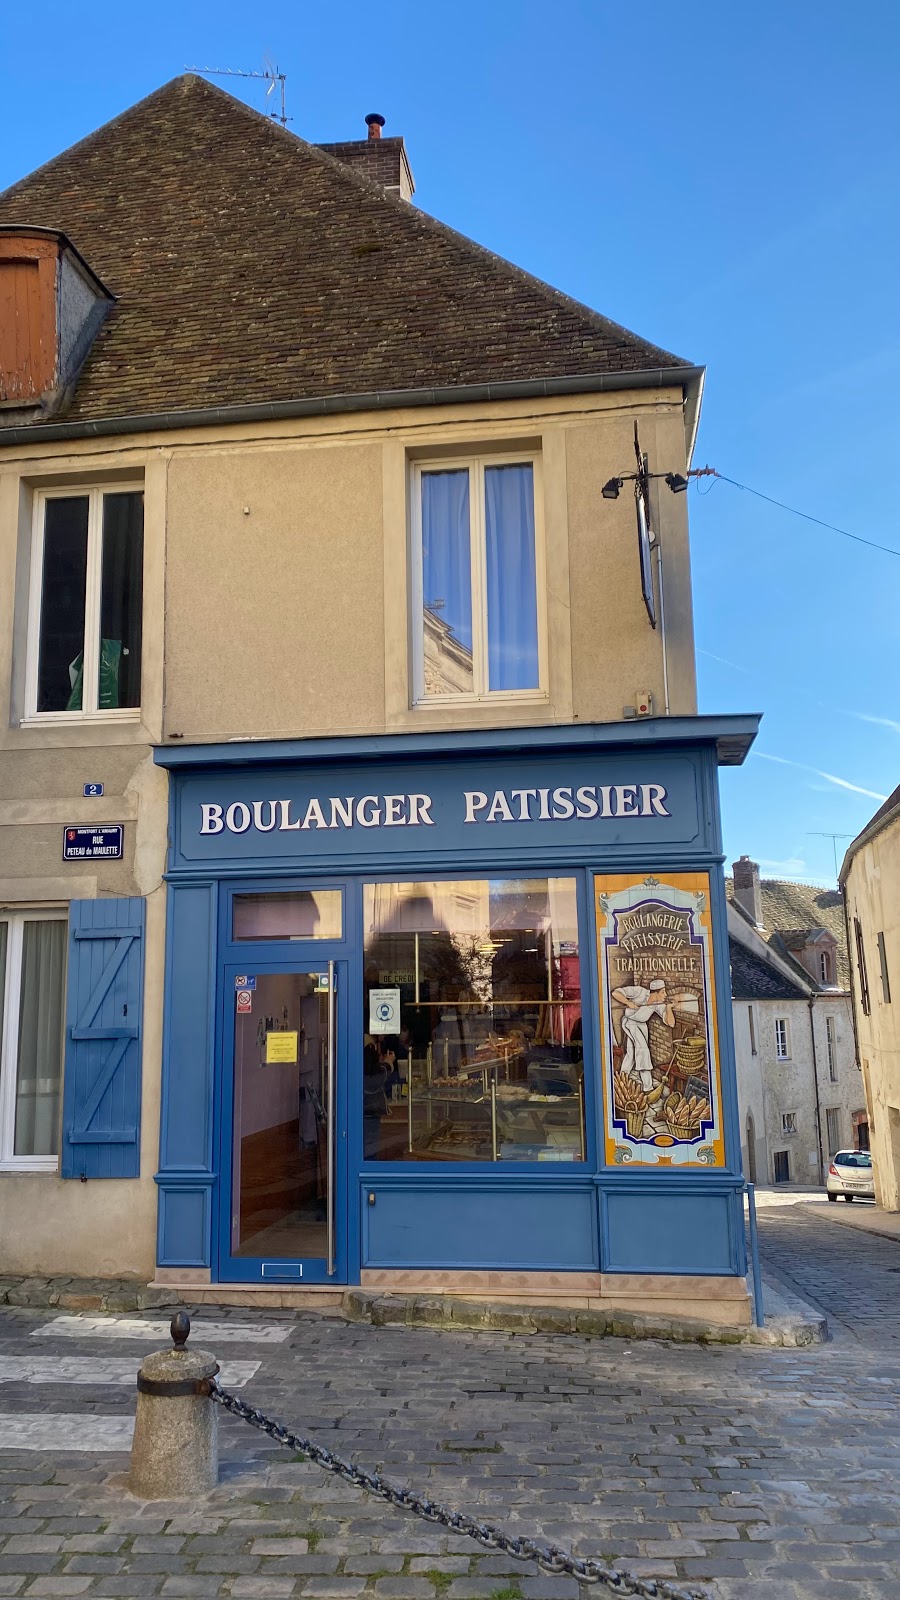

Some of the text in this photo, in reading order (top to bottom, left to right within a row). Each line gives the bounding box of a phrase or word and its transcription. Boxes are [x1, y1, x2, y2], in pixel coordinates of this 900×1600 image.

[89, 784, 97, 795] 2
[199, 783, 671, 835] BOULANGER PATISSIER
[92, 836, 104, 844] RUE
[67, 847, 85, 855] PETEAU
[93, 846, 118, 854] MAULETTE
[622, 913, 685, 932] BOULANGERIE
[620, 932, 686, 953] PATISSERIE
[615, 957, 697, 972] TRADITIONNELLE
[383, 974, 416, 983] DE CRÉDI
